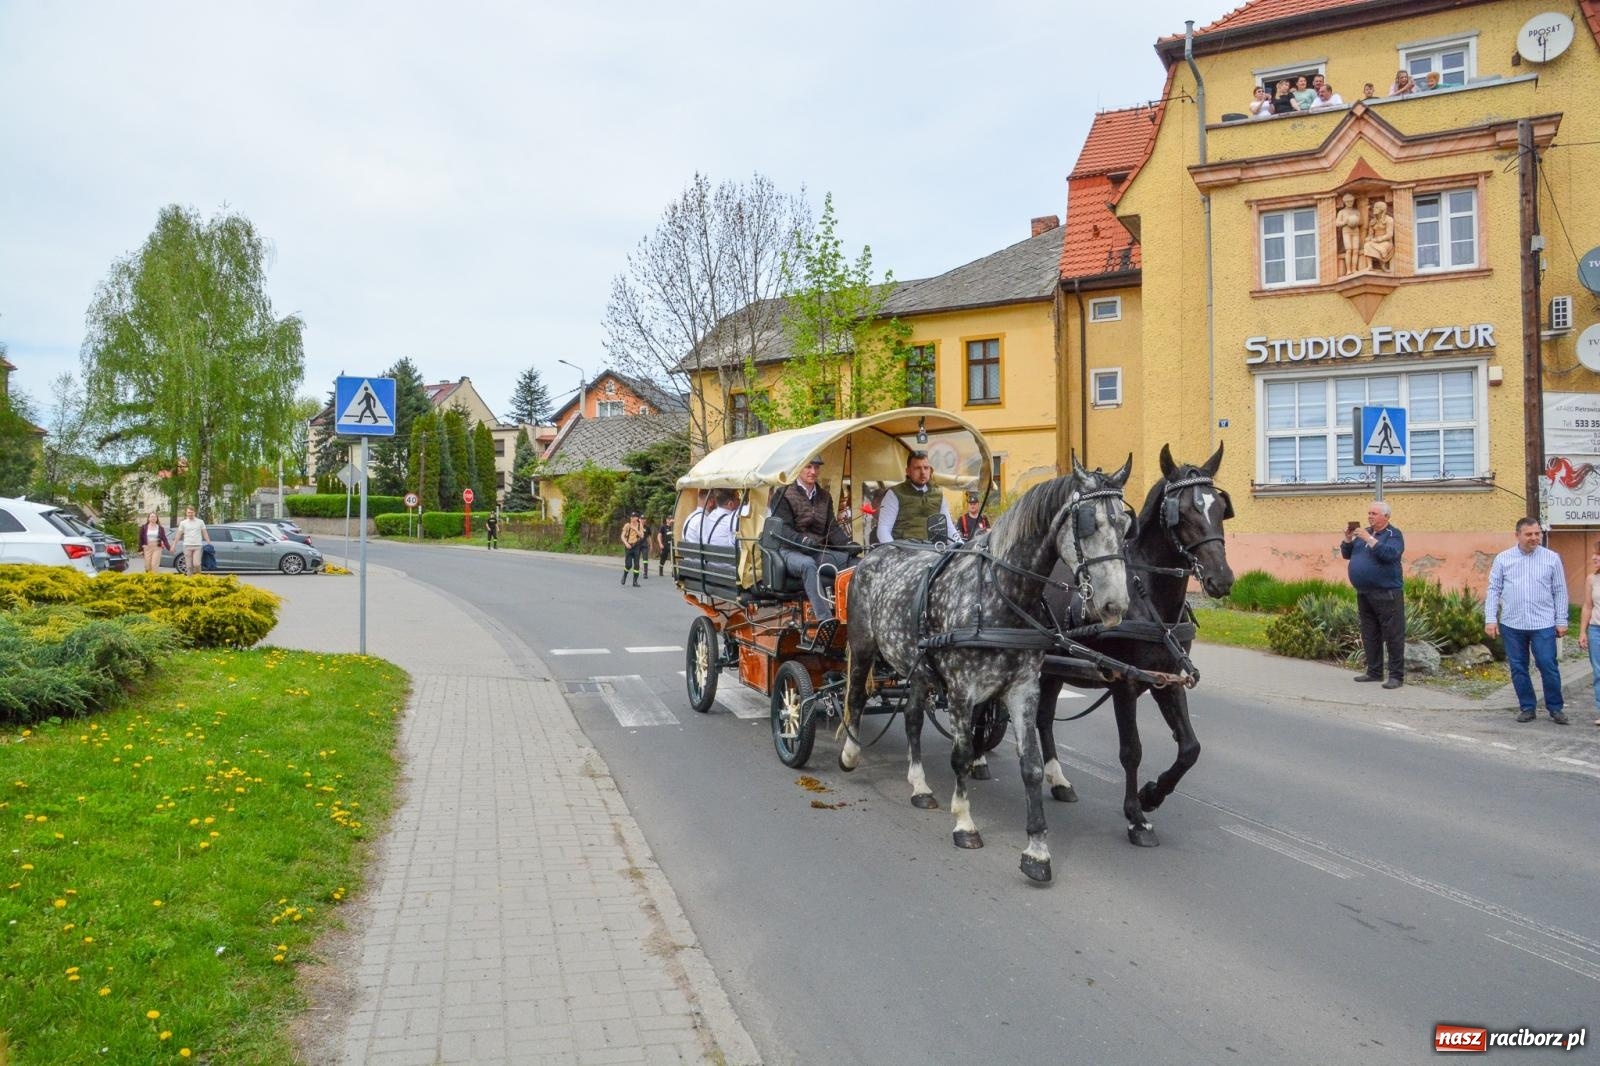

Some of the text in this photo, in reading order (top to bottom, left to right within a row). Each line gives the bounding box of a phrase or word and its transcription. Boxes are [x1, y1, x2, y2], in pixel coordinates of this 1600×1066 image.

[1245, 322, 1498, 365] STUDIO FRYZUR
[1575, 419, 1589, 428] 533
[406, 496, 417, 504] 40
